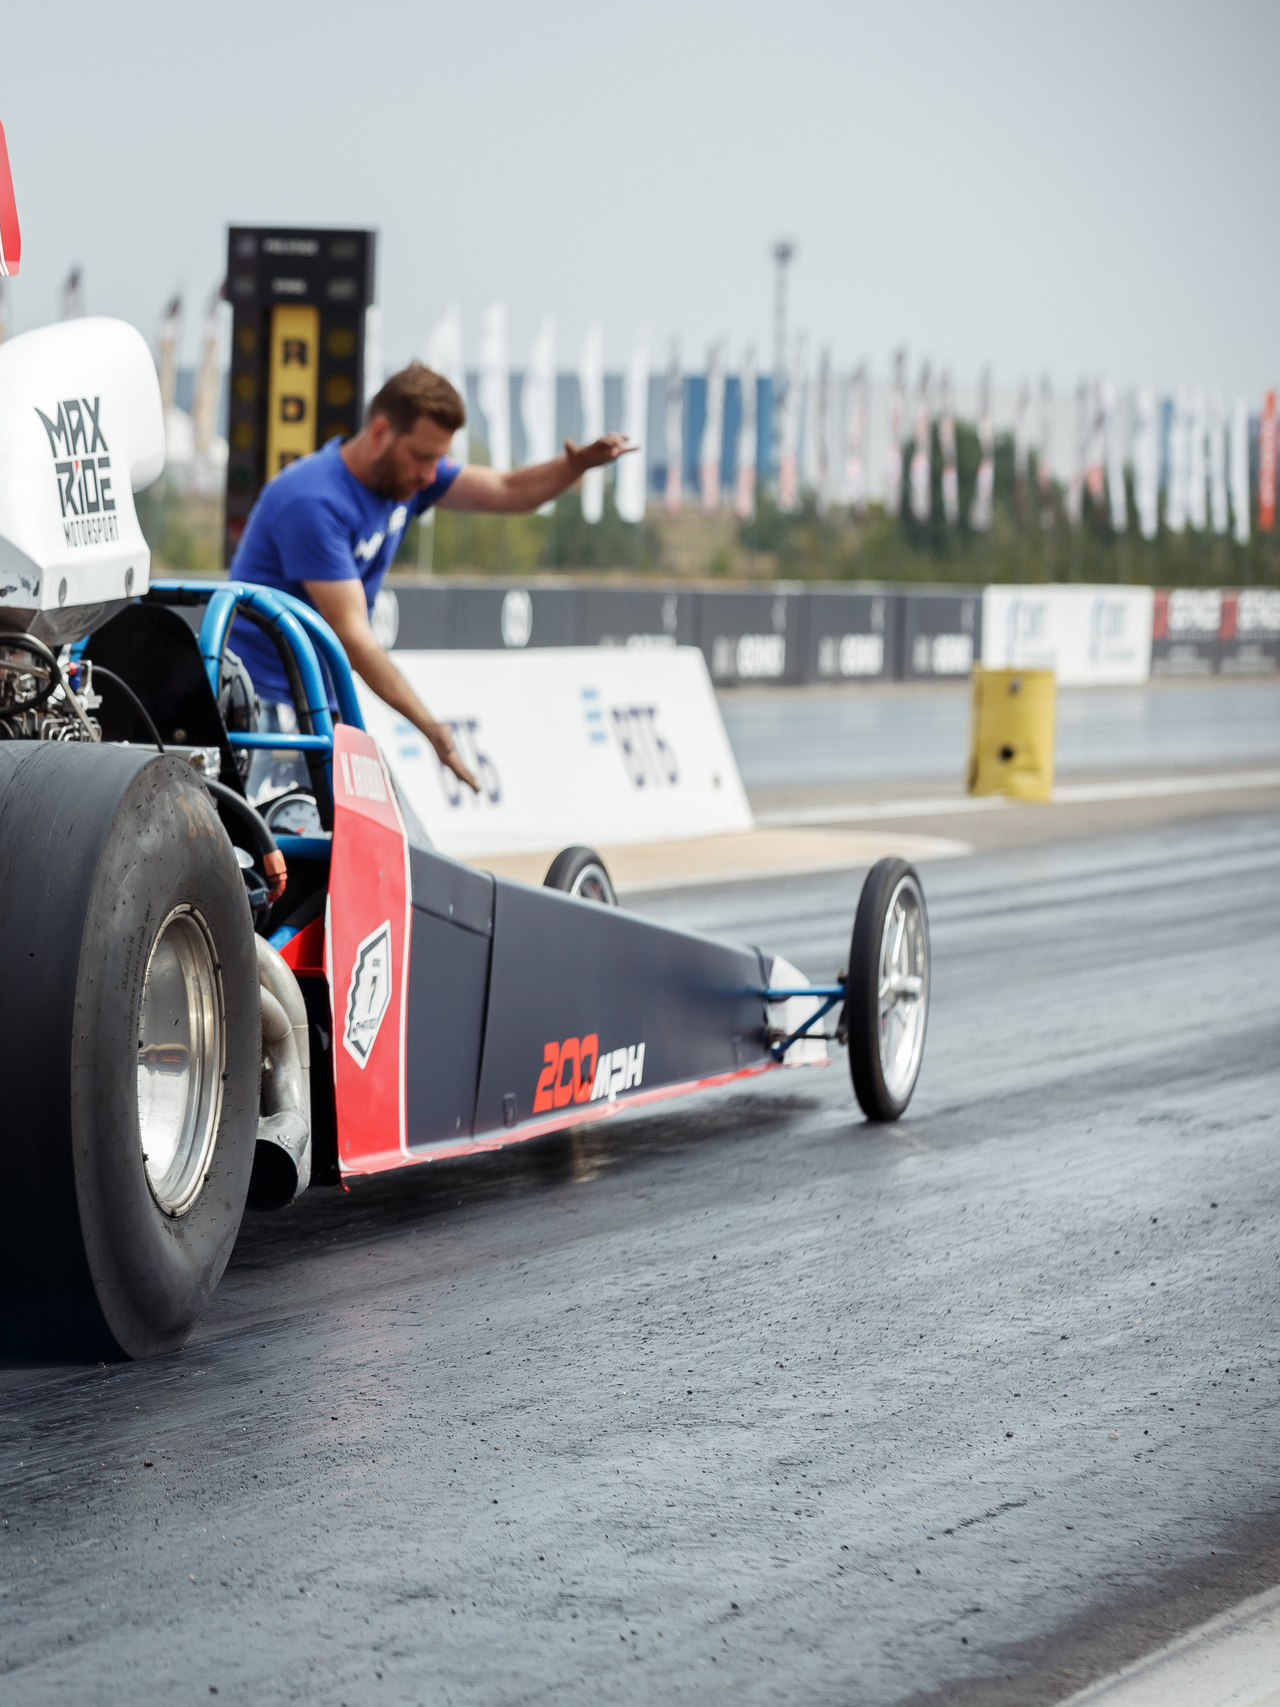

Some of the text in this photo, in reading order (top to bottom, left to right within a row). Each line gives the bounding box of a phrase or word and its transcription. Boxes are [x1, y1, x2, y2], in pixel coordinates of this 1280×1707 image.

[33, 396, 108, 458] MAX
[55, 456, 116, 517] RIDE
[63, 515, 119, 548] MOTORSPORT
